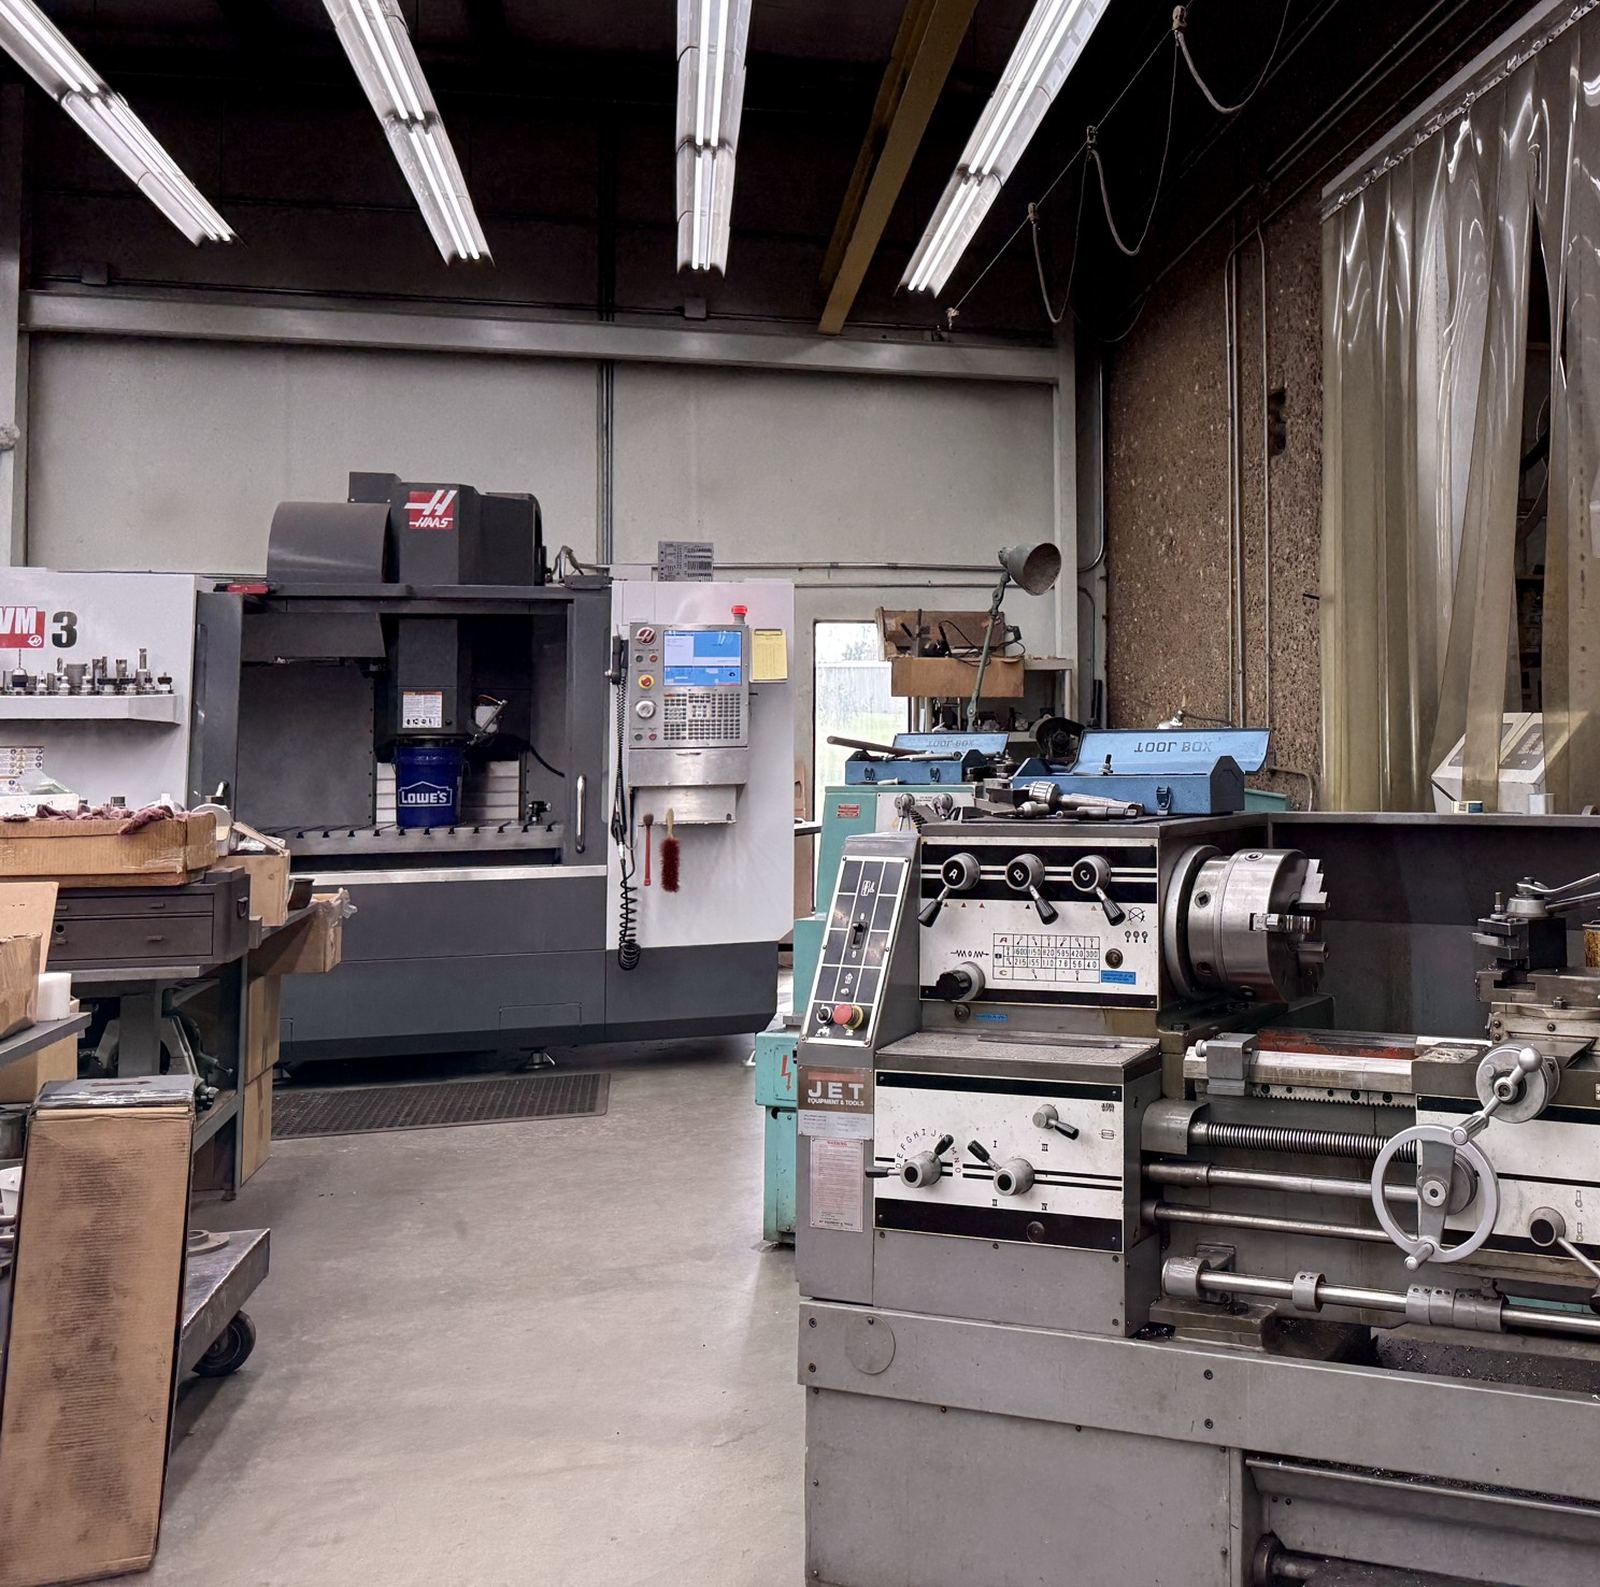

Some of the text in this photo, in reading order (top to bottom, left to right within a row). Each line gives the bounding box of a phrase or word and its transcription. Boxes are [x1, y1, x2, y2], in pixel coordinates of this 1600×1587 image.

[409, 517, 453, 528] HAAS
[52, 611, 77, 648] 3
[401, 790, 448, 804] LOWE'S
[948, 868, 958, 880] A
[1013, 868, 1024, 881] B
[1080, 869, 1091, 880] C
[808, 1081, 864, 1100] JET
[808, 1097, 839, 1105] EQUIPMENT
